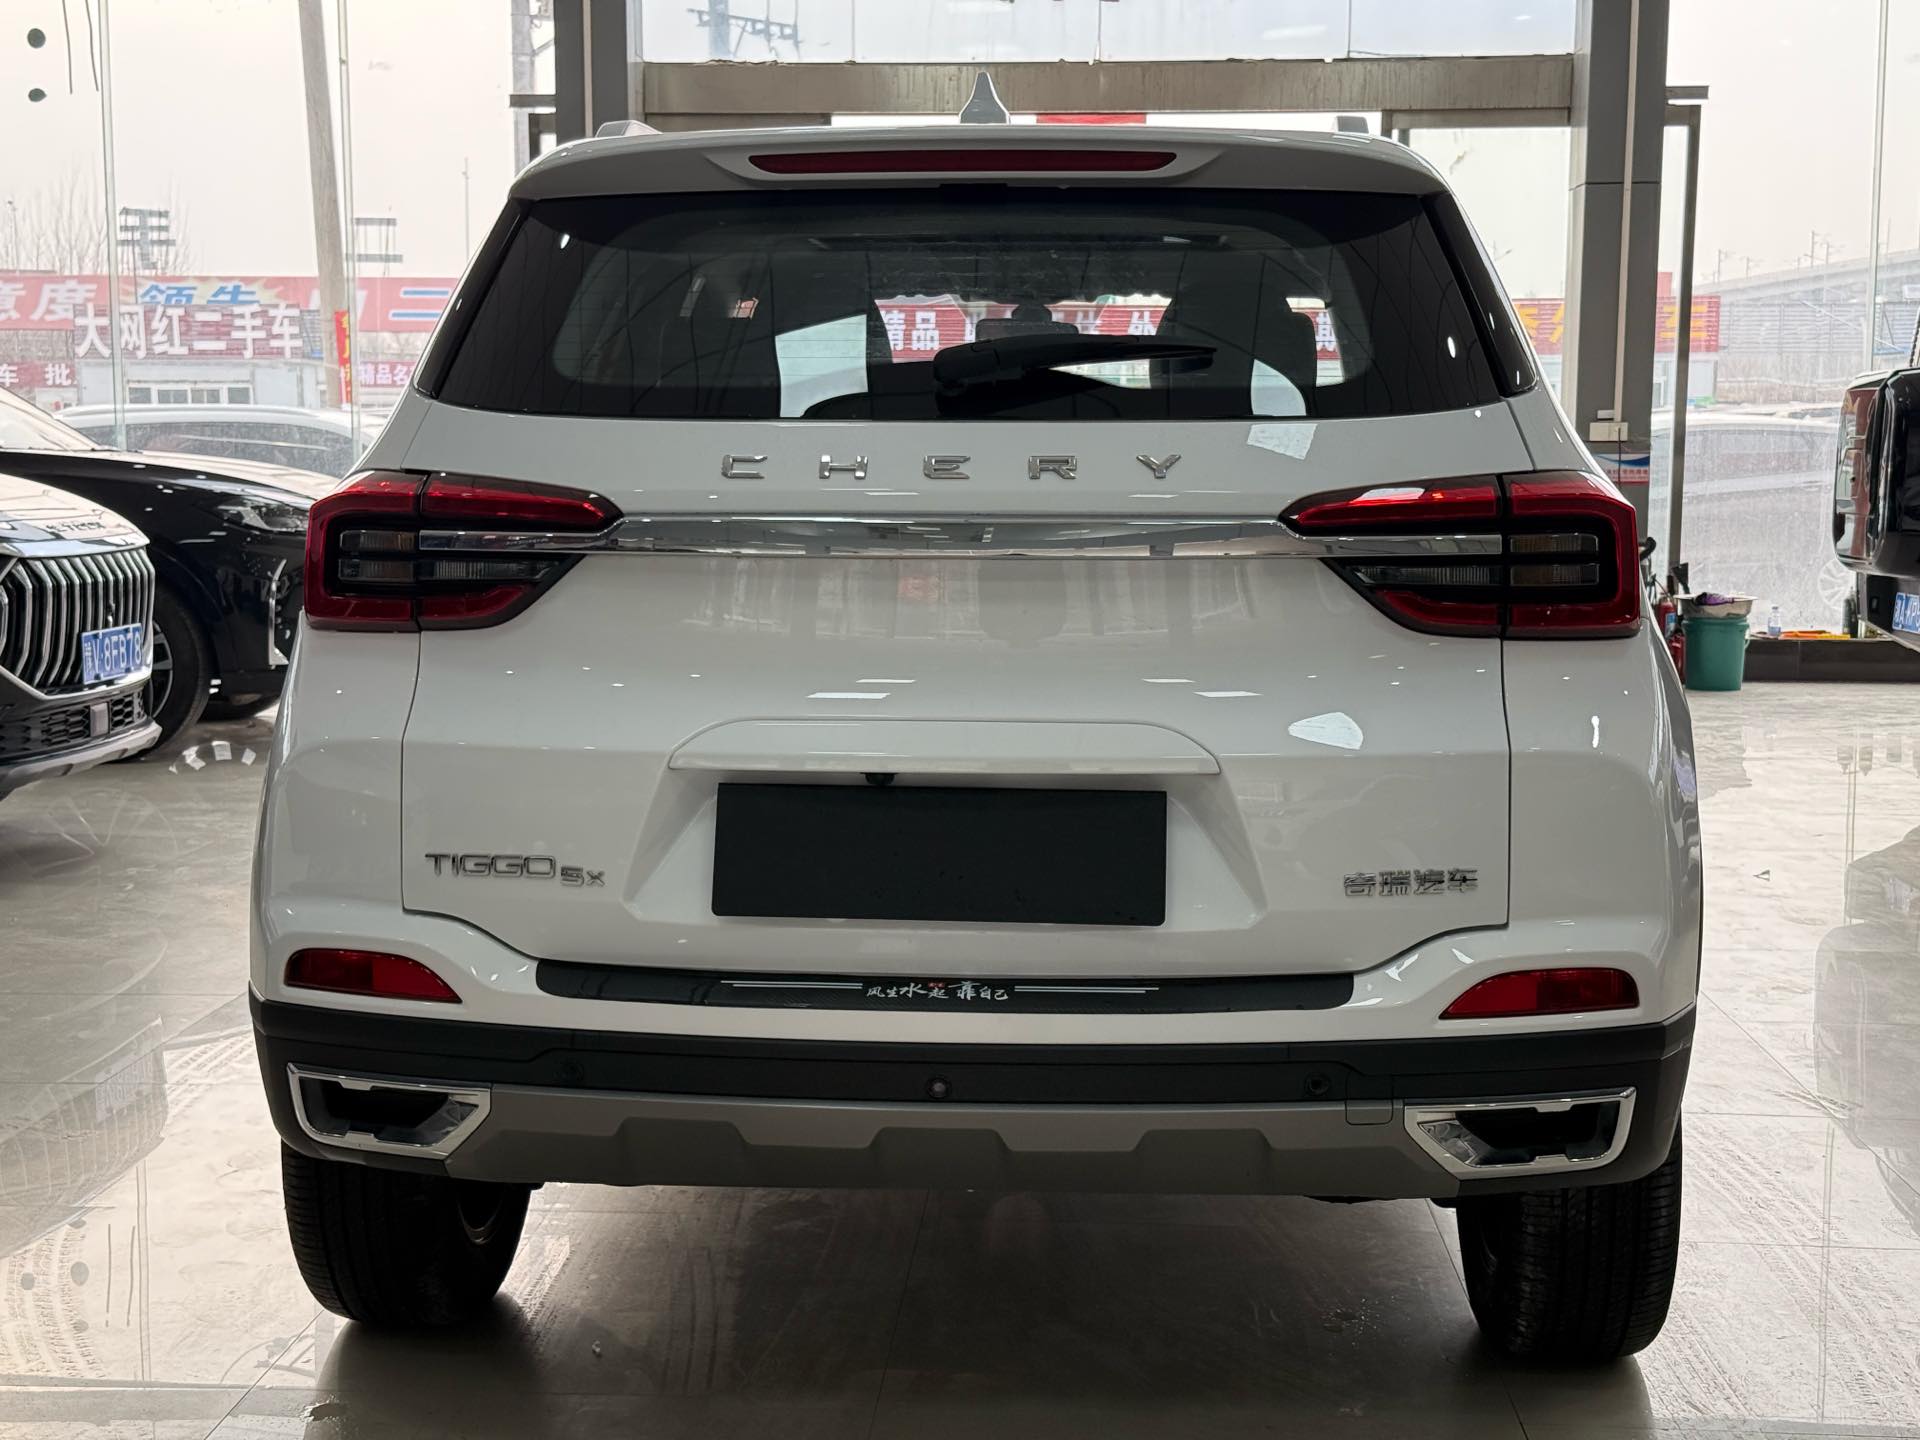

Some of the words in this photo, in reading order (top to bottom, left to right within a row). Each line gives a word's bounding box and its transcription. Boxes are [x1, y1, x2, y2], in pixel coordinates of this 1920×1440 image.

[75, 302, 304, 359] 大网红二手车
[44, 363, 78, 386] 批
[359, 362, 415, 385] 精品名
[721, 453, 1181, 480] CHERY
[425, 853, 556, 879] TIGGO
[1344, 868, 1479, 897] 奇瑞汽车
